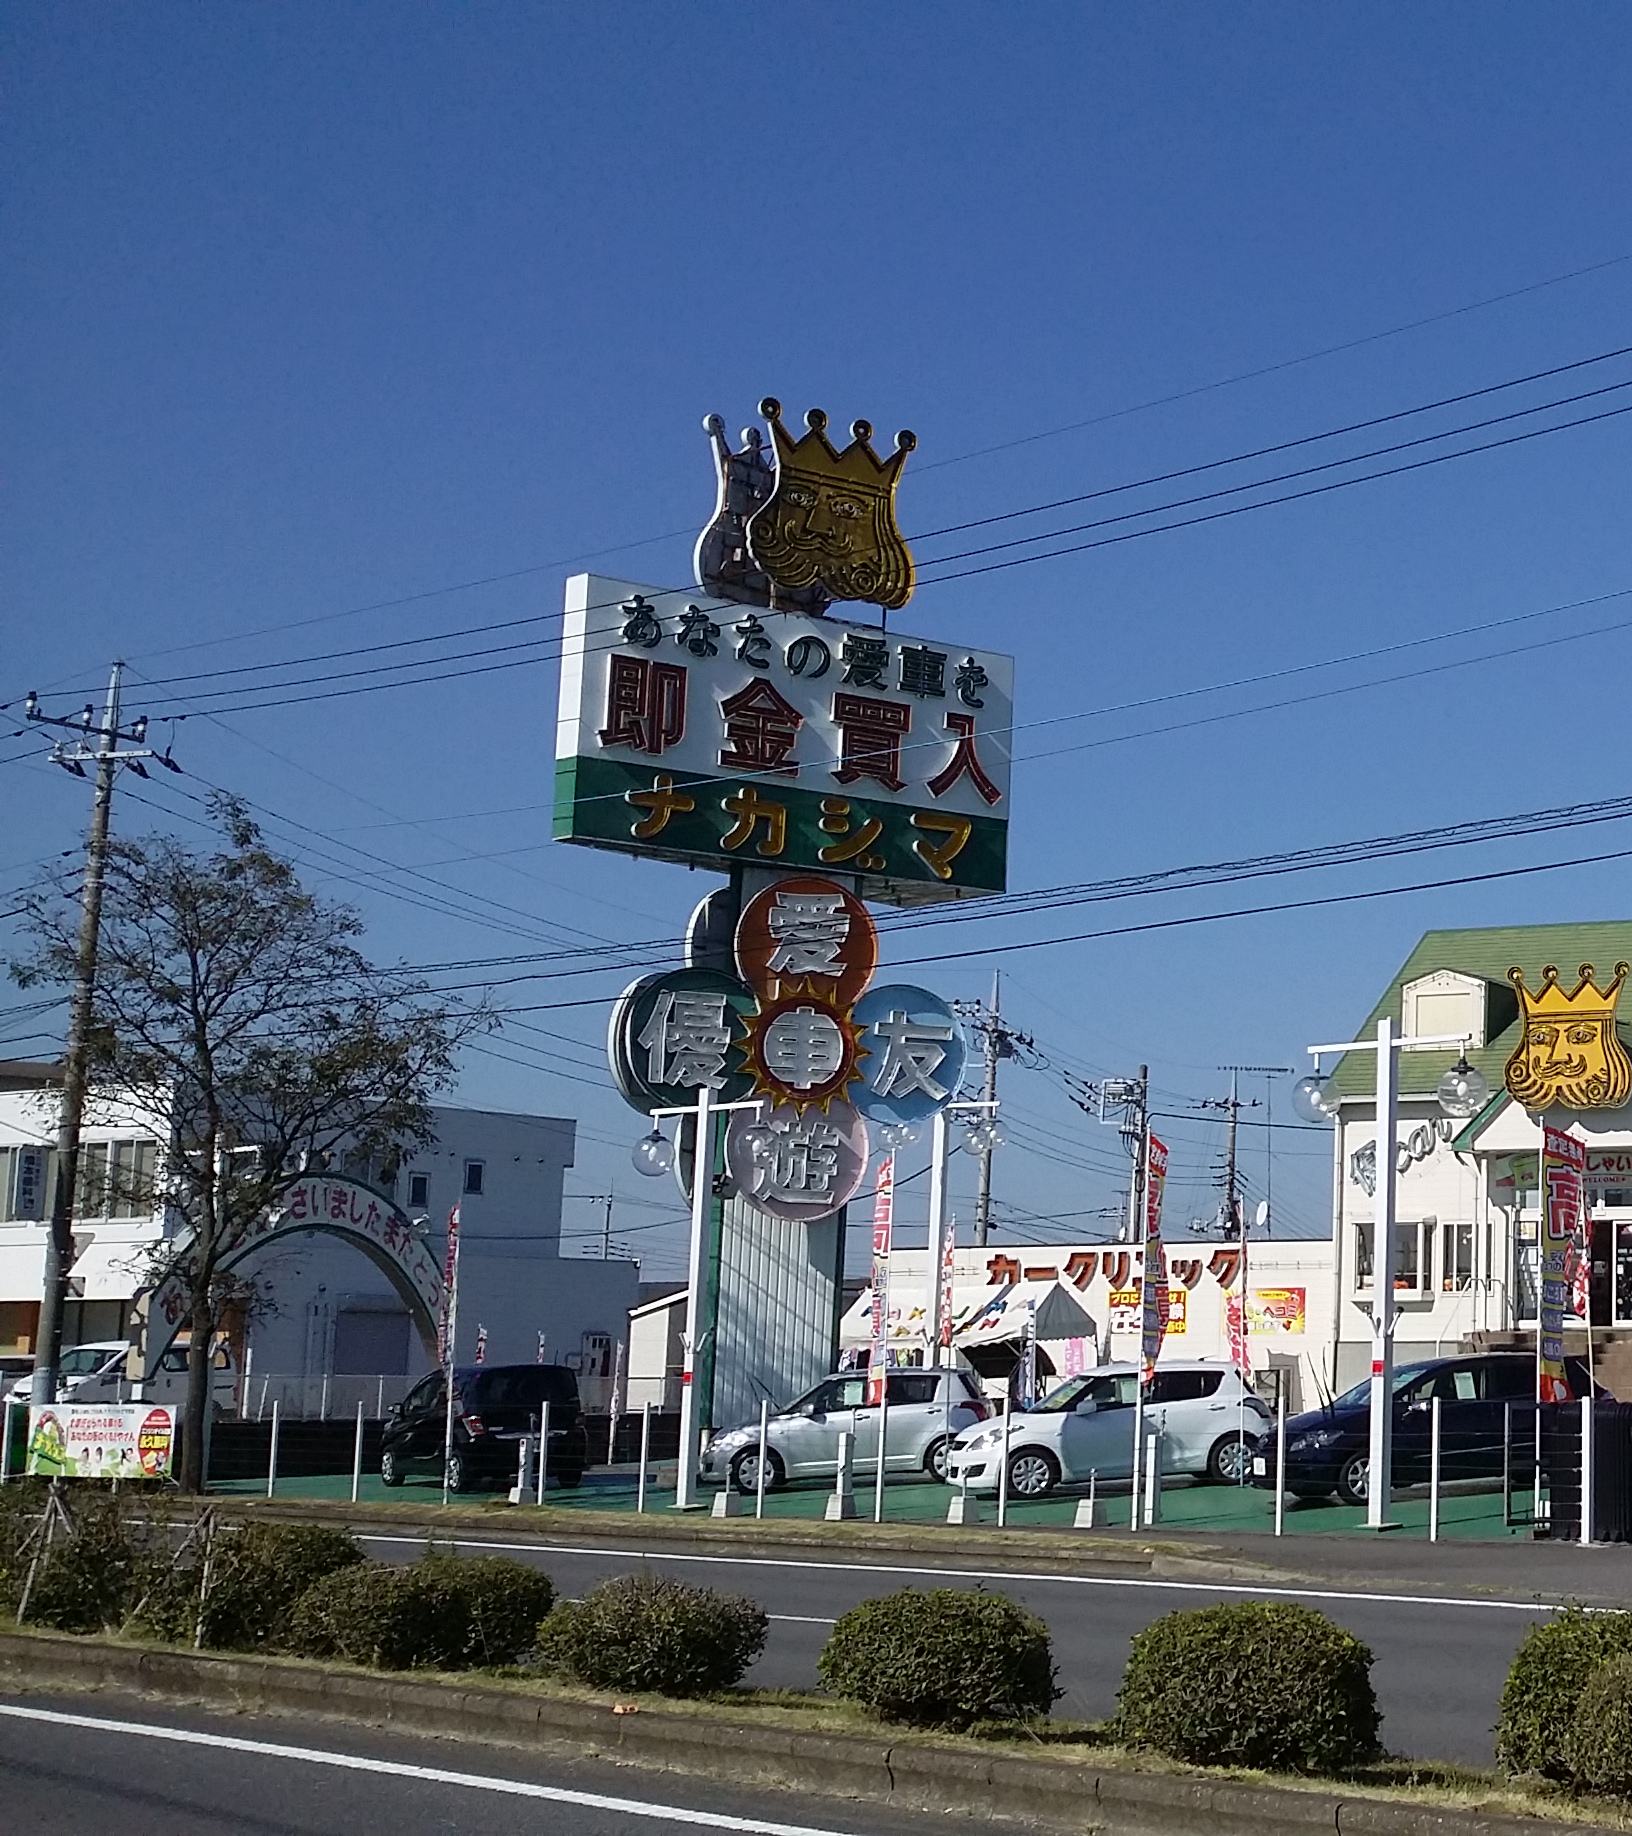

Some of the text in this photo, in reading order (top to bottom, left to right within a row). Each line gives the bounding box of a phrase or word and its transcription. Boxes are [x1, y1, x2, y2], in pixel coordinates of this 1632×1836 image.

[618, 594, 988, 709] あなたの愛車を
[597, 653, 1003, 807] 即金買入
[624, 773, 972, 880] ナカジマ
[766, 891, 850, 977] 愛
[637, 989, 732, 1088] 優
[763, 1006, 844, 1090] 車
[871, 1010, 954, 1100] 友
[752, 1122, 840, 1205] 遊
[986, 1249, 1243, 1293] カークリック
